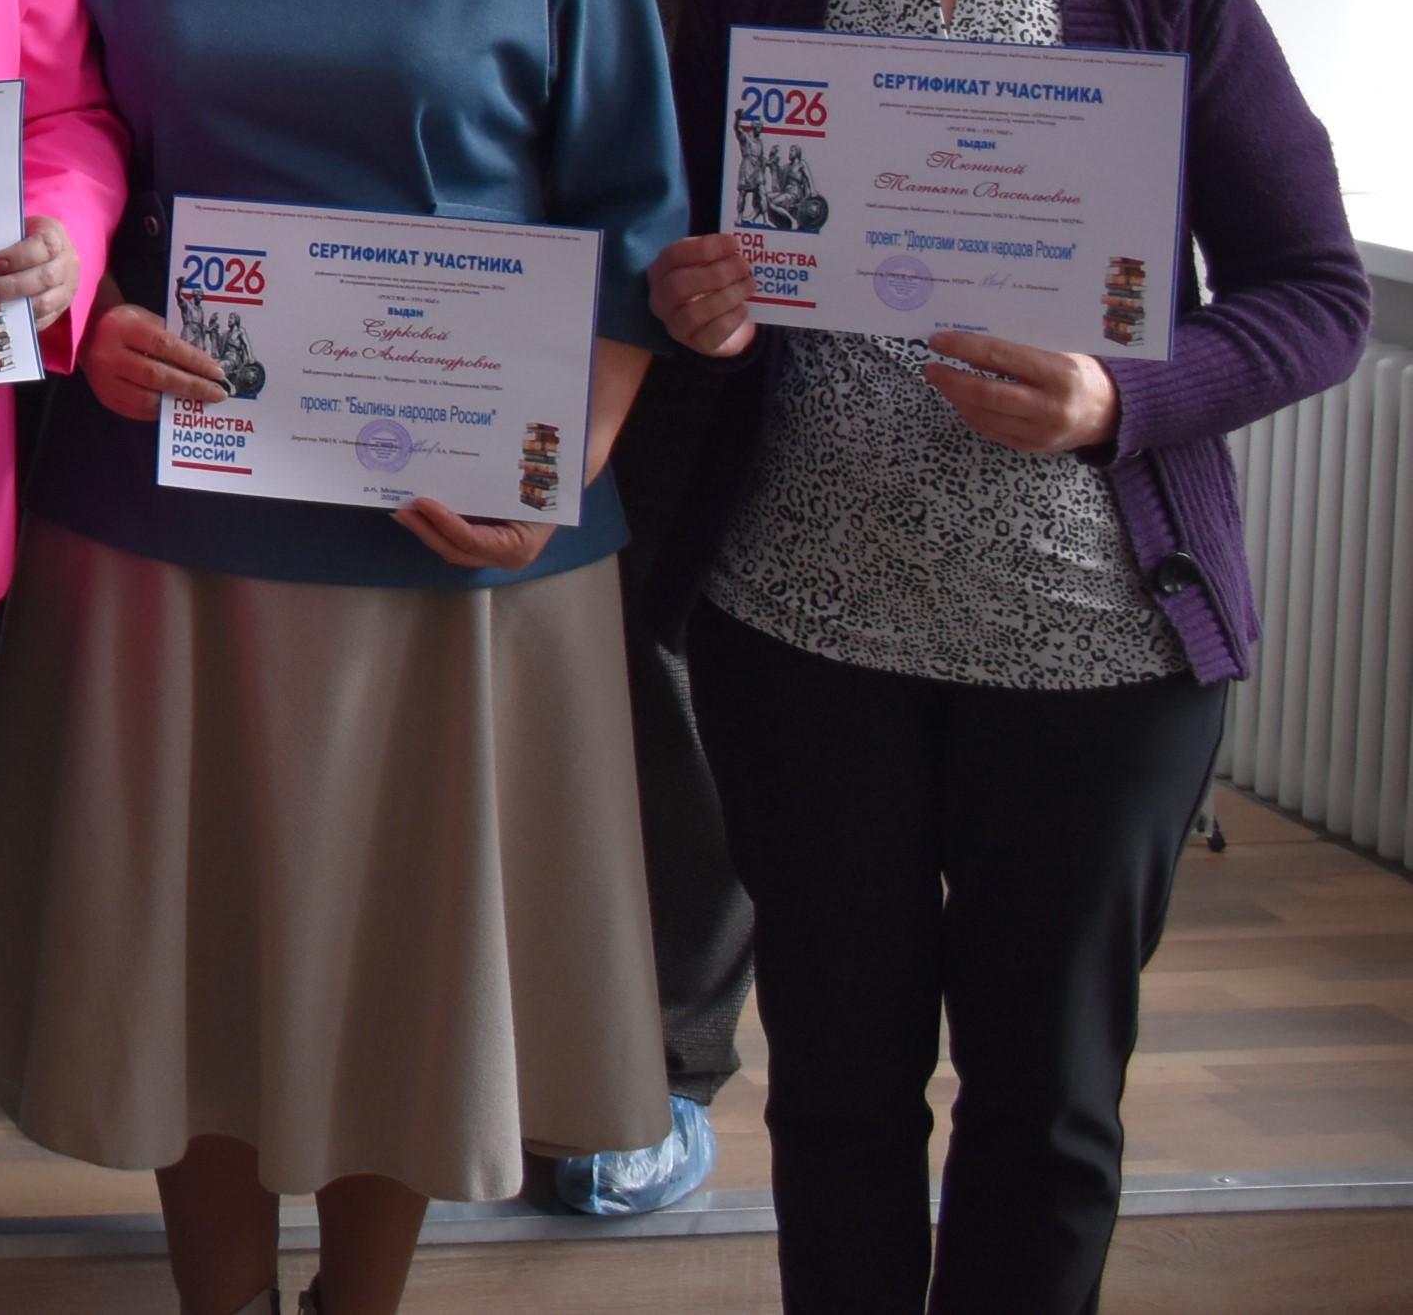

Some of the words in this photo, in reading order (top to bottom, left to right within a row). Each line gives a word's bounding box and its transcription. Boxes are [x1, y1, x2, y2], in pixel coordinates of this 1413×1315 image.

[872, 72, 990, 96] СЕРТИФИКАТ
[995, 80, 1103, 104] УЧАСТНИКА
[739, 85, 827, 127] 2026
[956, 138, 996, 150] выдан
[925, 150, 1027, 175] Тюниной
[873, 171, 968, 195] Татьяне
[972, 181, 1081, 204] Васильевне
[865, 230, 901, 248] проект:
[903, 228, 955, 252] "Дорогами
[957, 237, 989, 253] сказок
[990, 240, 1033, 258] народов
[1034, 239, 1076, 260] России"
[308, 241, 419, 265] СЕРТИФИКАТ
[423, 251, 523, 274] УЧАСТНИКА
[734, 248, 817, 269] ДИНСТВА
[180, 254, 265, 295] 2026
[747, 265, 808, 284] РОДОВ
[387, 306, 423, 318] выдан
[362, 317, 450, 342] Сурковой
[308, 338, 358, 361] Вере
[361, 344, 501, 372] Александровне
[173, 396, 205, 414] ГОД
[299, 395, 342, 413] проект:
[344, 395, 396, 417] "Былины
[398, 404, 446, 423] народов
[449, 404, 496, 426] России"
[172, 412, 254, 433] ЕДИНСТВА
[172, 428, 246, 448] НАРОДОВ
[171, 443, 235, 462] РОССИИ
